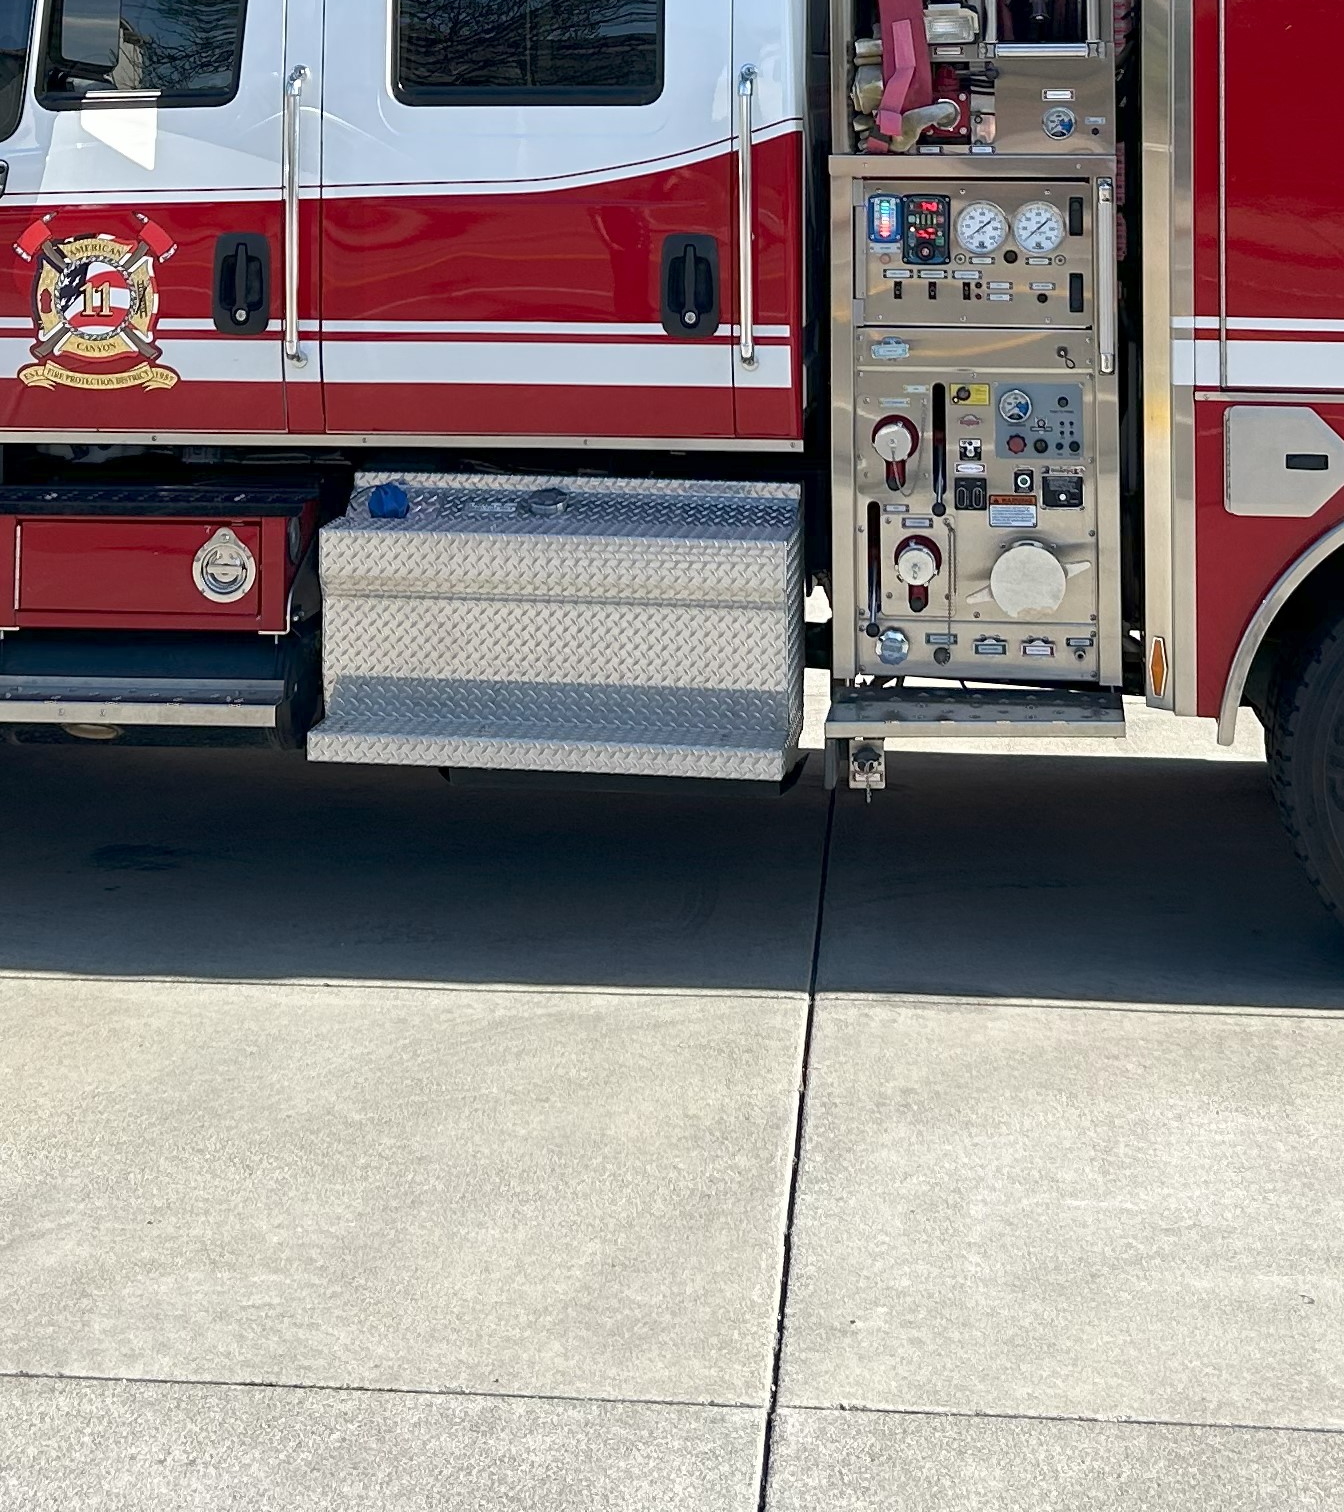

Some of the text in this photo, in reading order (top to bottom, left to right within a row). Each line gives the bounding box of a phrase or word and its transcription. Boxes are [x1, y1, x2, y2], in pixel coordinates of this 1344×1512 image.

[69, 243, 122, 256] AMERICAN
[79, 281, 113, 317] 11
[76, 342, 117, 352] CANYON
[46, 367, 64, 381] FIRE
[65, 374, 114, 386] PROTECTION
[115, 368, 150, 385] DISTRICT
